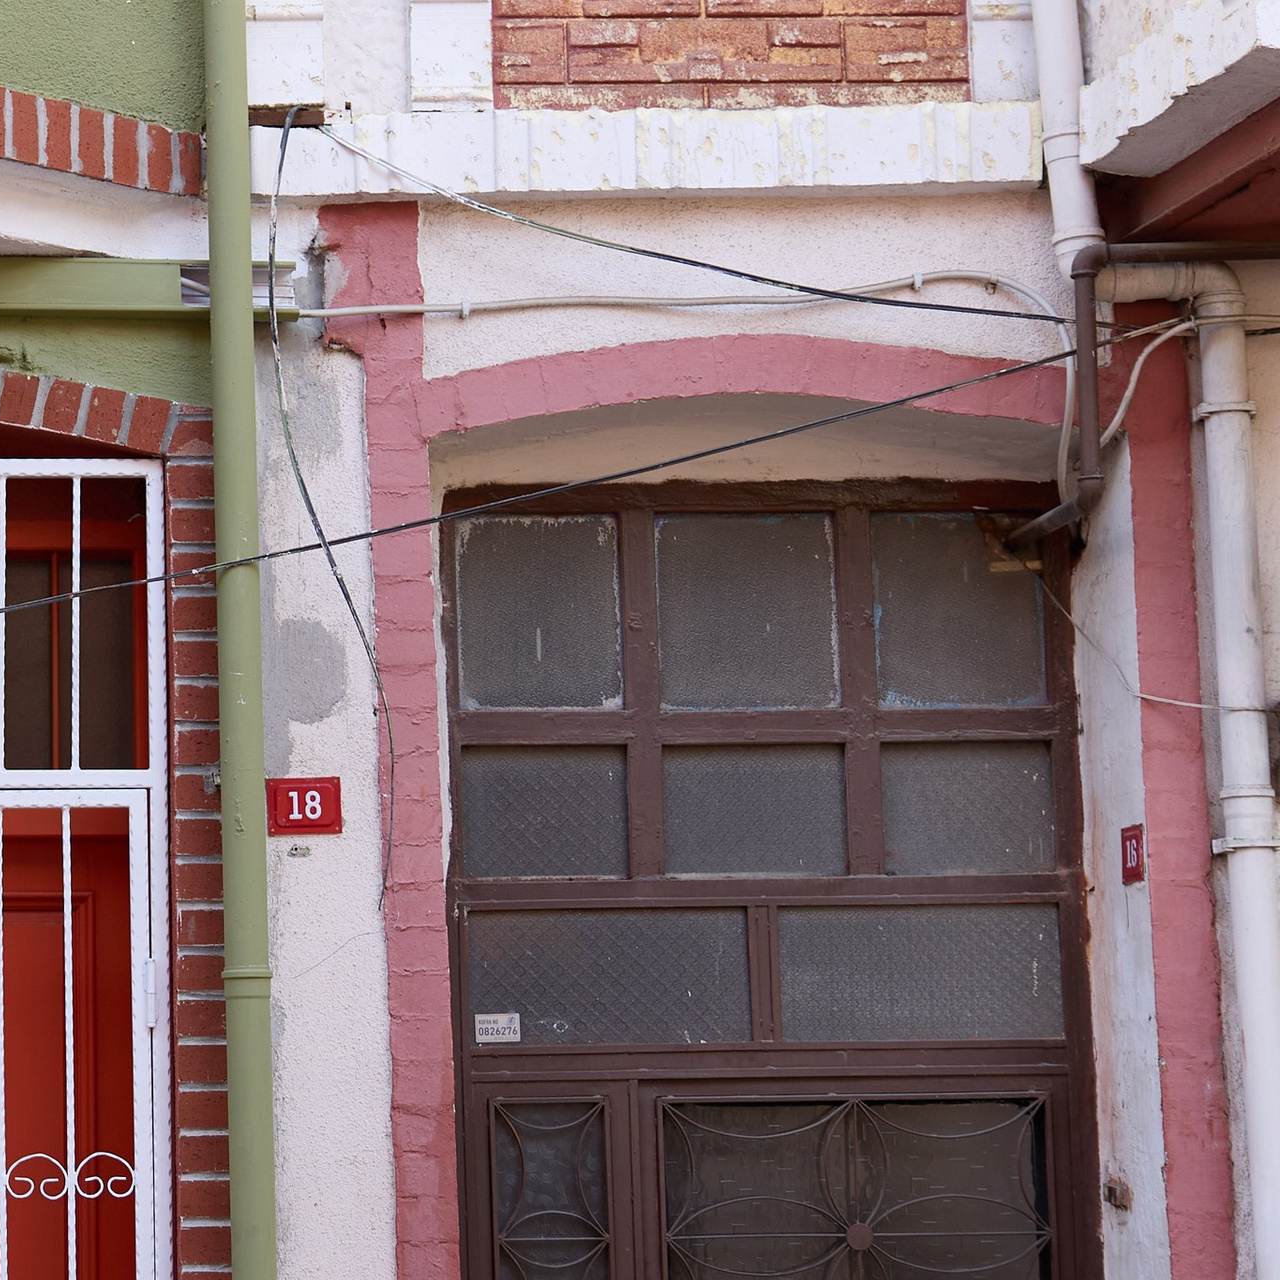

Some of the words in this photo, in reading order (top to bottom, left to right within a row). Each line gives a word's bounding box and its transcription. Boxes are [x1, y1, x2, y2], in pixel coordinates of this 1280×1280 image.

[288, 790, 322, 820] 18
[1126, 838, 1137, 868] 16
[478, 1026, 518, 1036] 0826276
